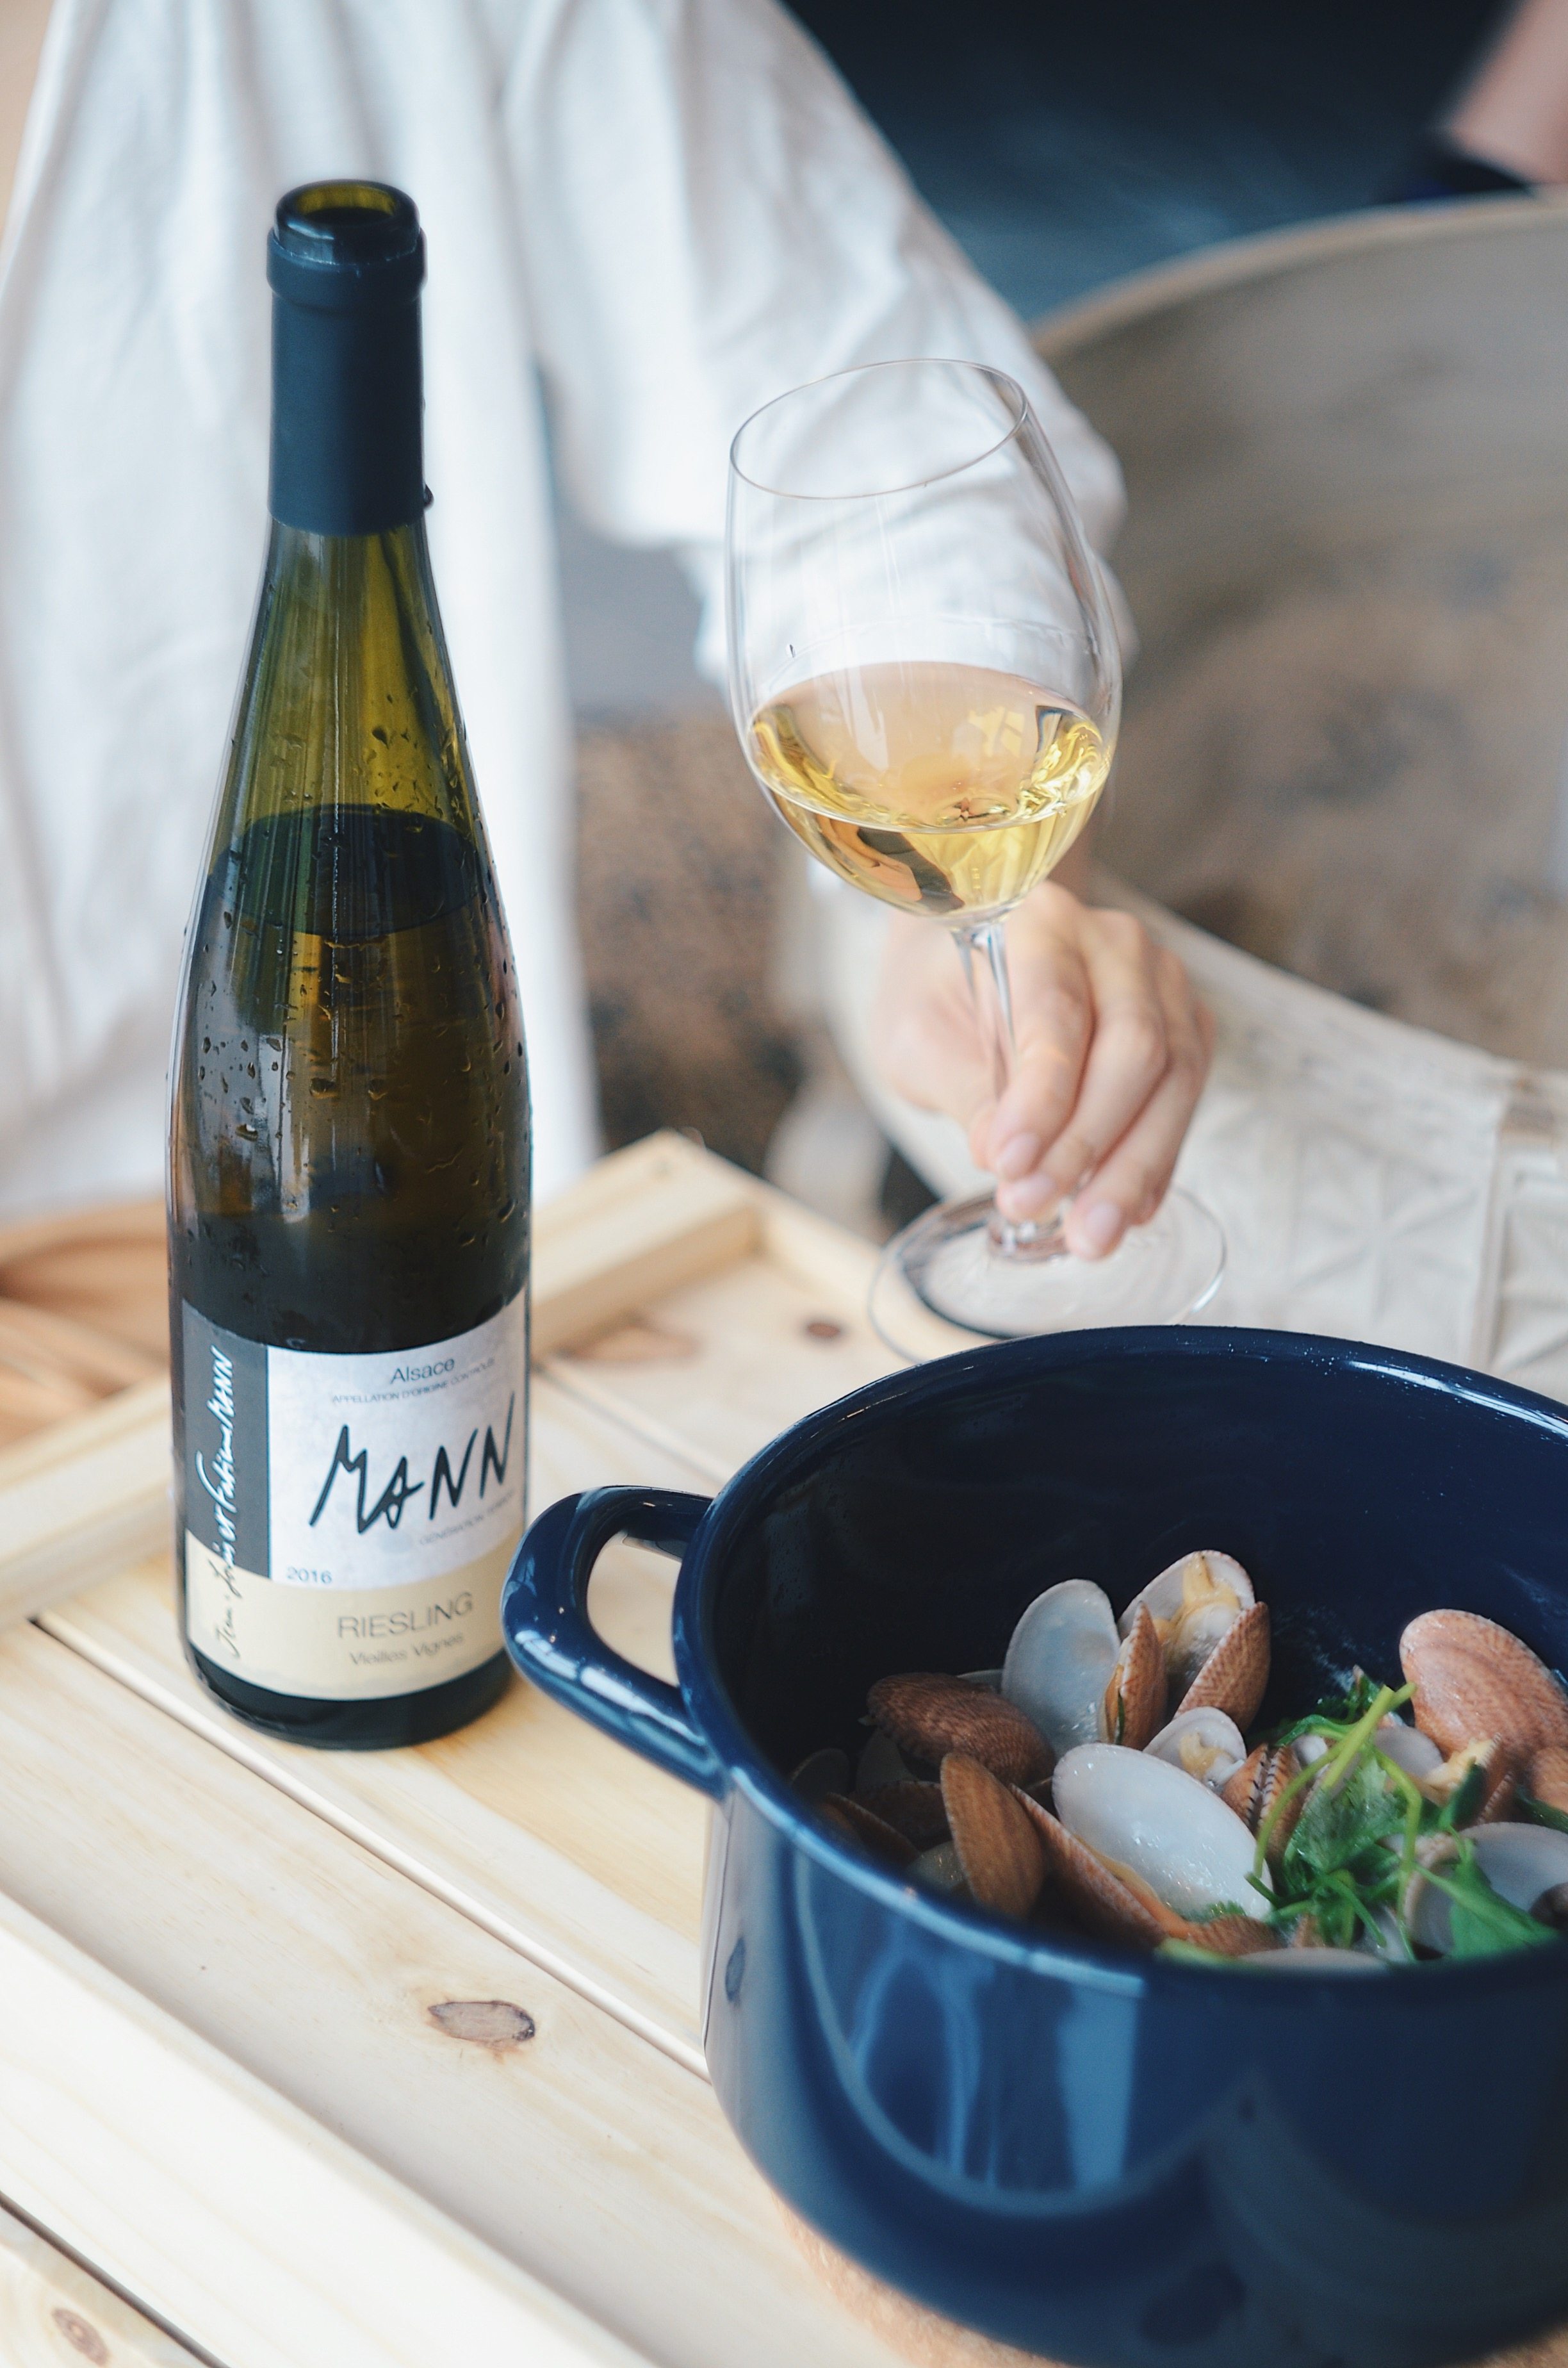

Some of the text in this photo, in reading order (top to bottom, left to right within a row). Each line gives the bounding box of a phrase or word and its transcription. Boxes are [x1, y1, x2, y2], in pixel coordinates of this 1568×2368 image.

[389, 1358, 455, 1385] Alsace
[332, 1390, 399, 1404] APPELLATION
[309, 1390, 514, 1534] MANN
[287, 1566, 332, 1584] 2016
[338, 1591, 473, 1638] RIESLING
[350, 1632, 464, 1665] Vieilles Vignes
